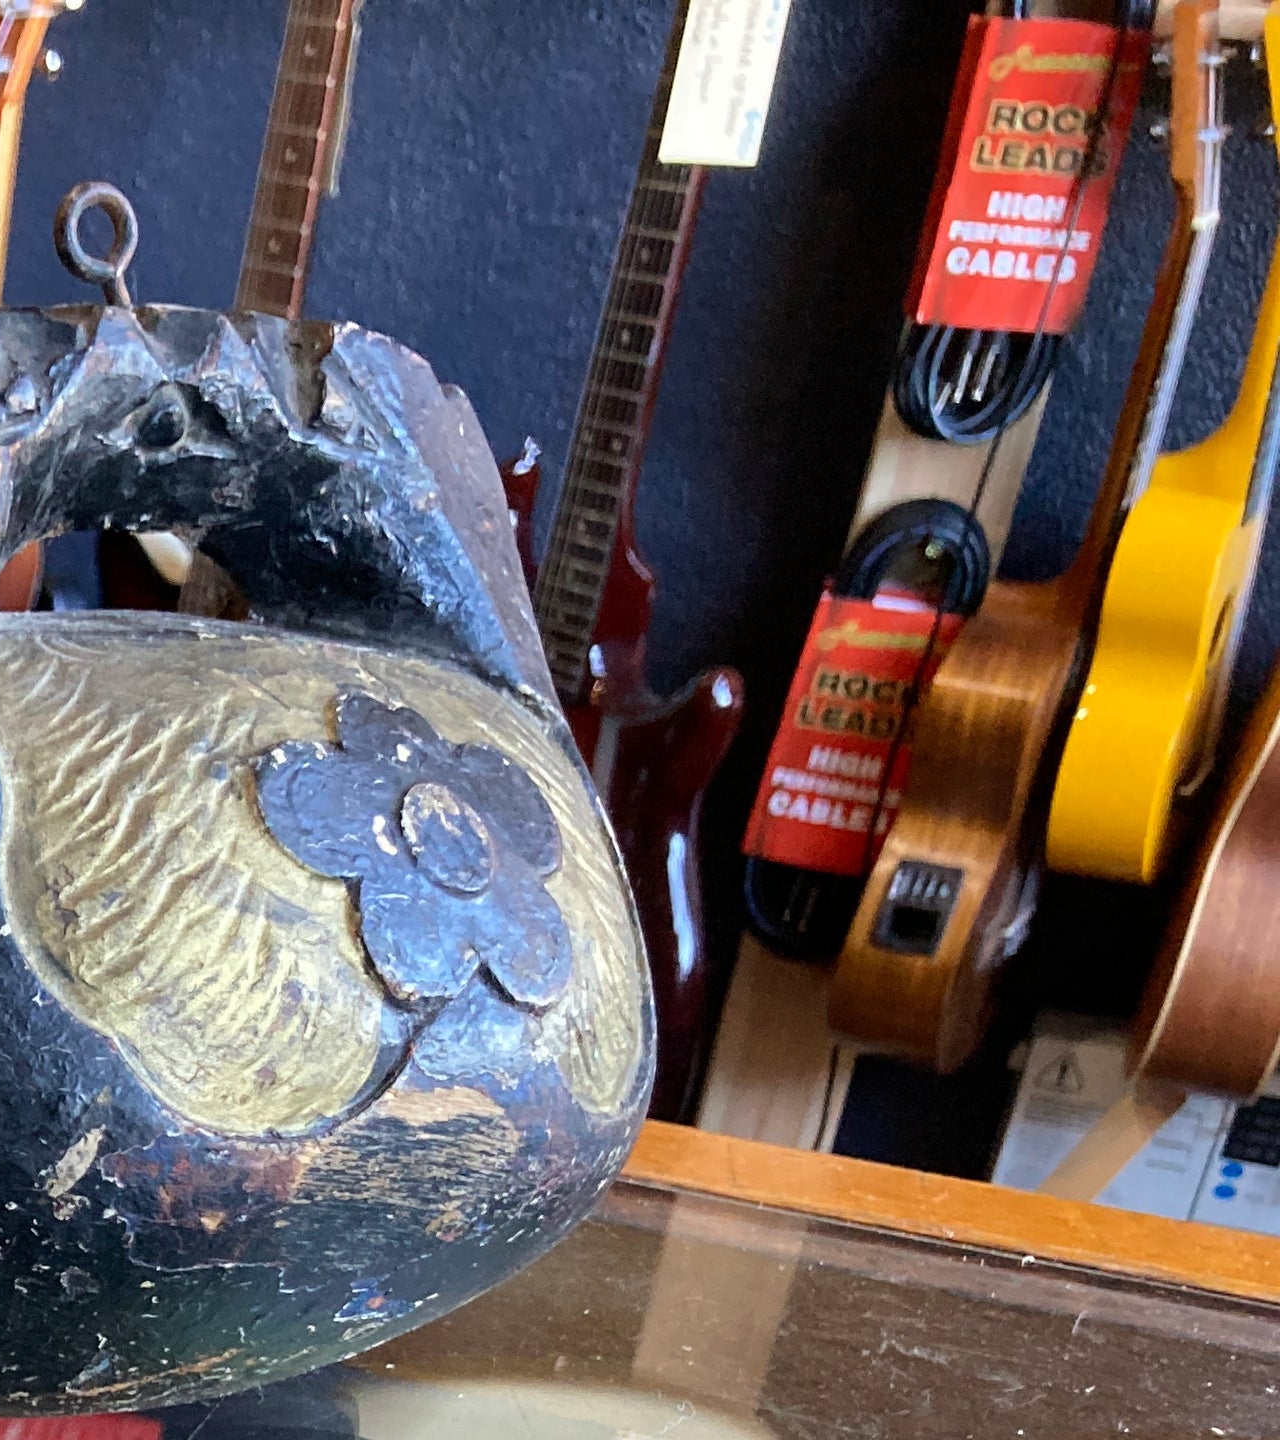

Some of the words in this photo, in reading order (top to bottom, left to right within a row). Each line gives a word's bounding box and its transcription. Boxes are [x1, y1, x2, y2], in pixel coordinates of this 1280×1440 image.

[987, 191, 1068, 223] HIGH
[946, 246, 1077, 284] CABLES
[794, 694, 905, 742] LEAD
